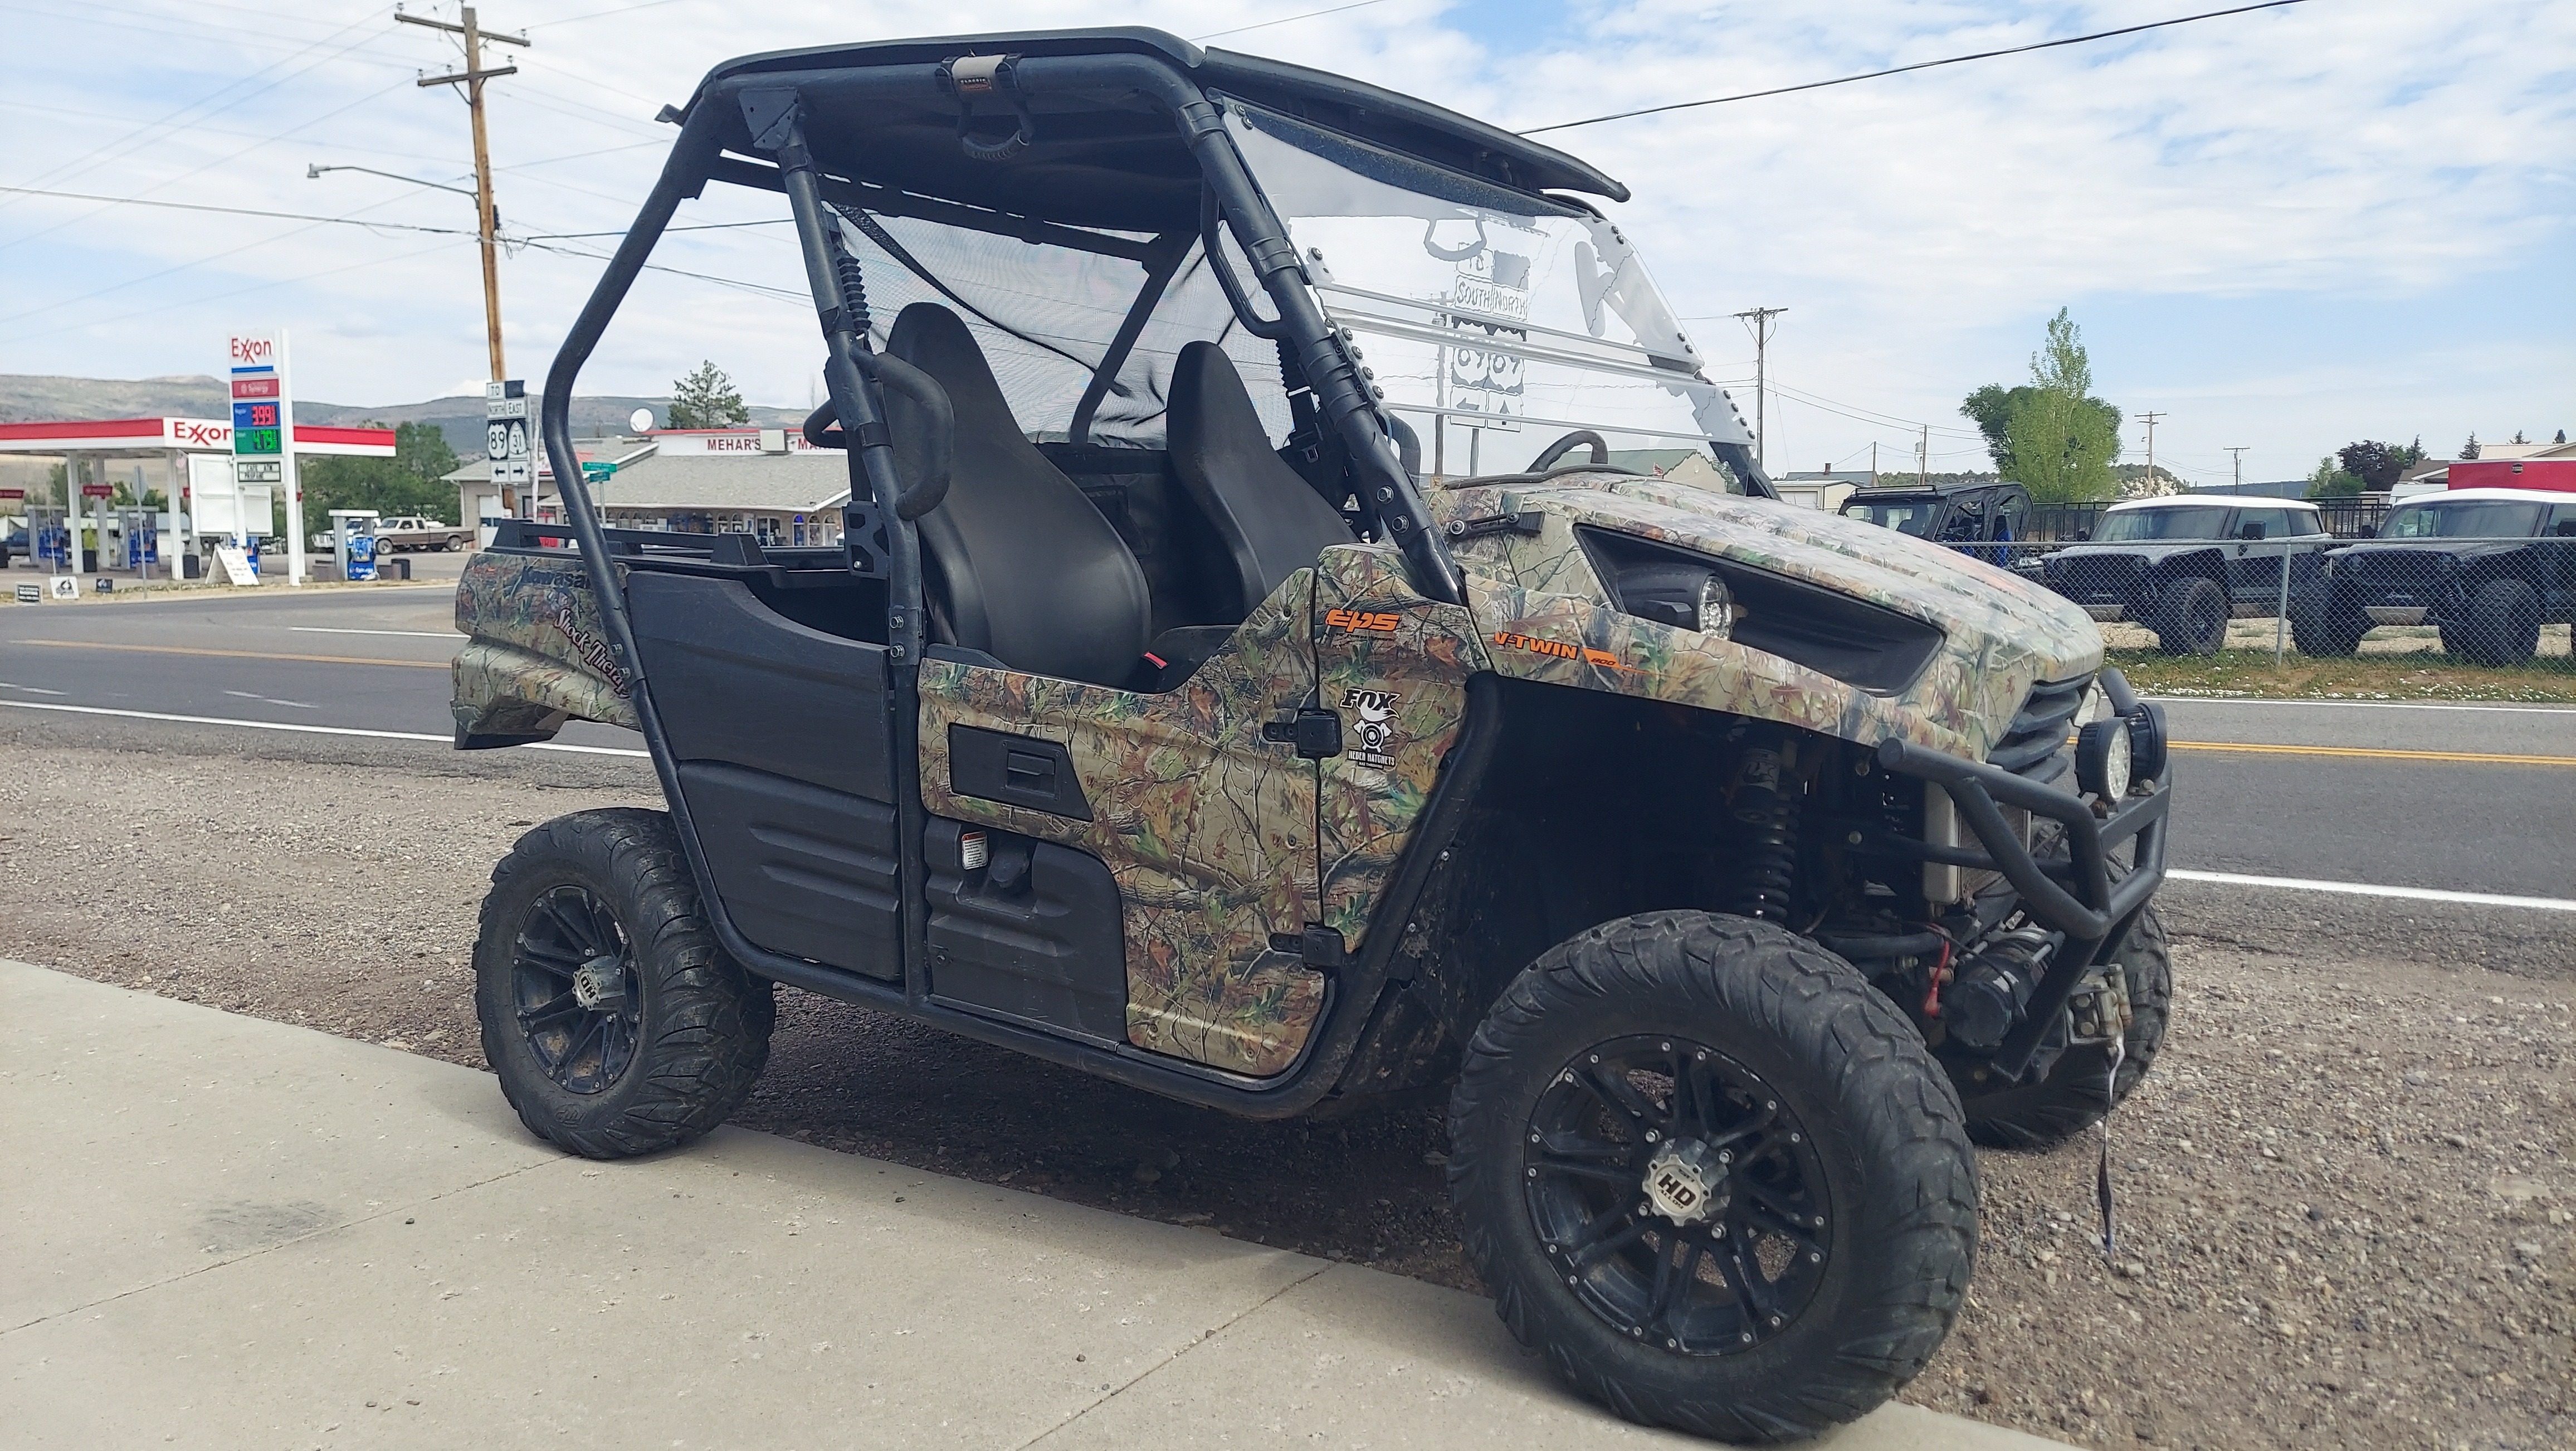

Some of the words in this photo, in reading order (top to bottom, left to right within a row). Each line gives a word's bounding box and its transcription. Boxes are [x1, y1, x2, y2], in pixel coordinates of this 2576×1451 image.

[1457, 281, 1491, 308] SOUTH
[1495, 291, 1525, 316] NORTH
[232, 337, 272, 363] Exxon
[491, 386, 500, 396] TO
[509, 402, 522, 414] EAST
[491, 431, 505, 450] 89
[513, 434, 522, 447] 31
[707, 439, 761, 451] MEHAR'S
[553, 607, 591, 654] Shock
[1494, 631, 1579, 660] V-TWIN
[1339, 687, 1402, 712] FOX
[1367, 753, 1396, 766] HATCHETS
[581, 976, 597, 999] HD
[1657, 1172, 1697, 1206] HD
